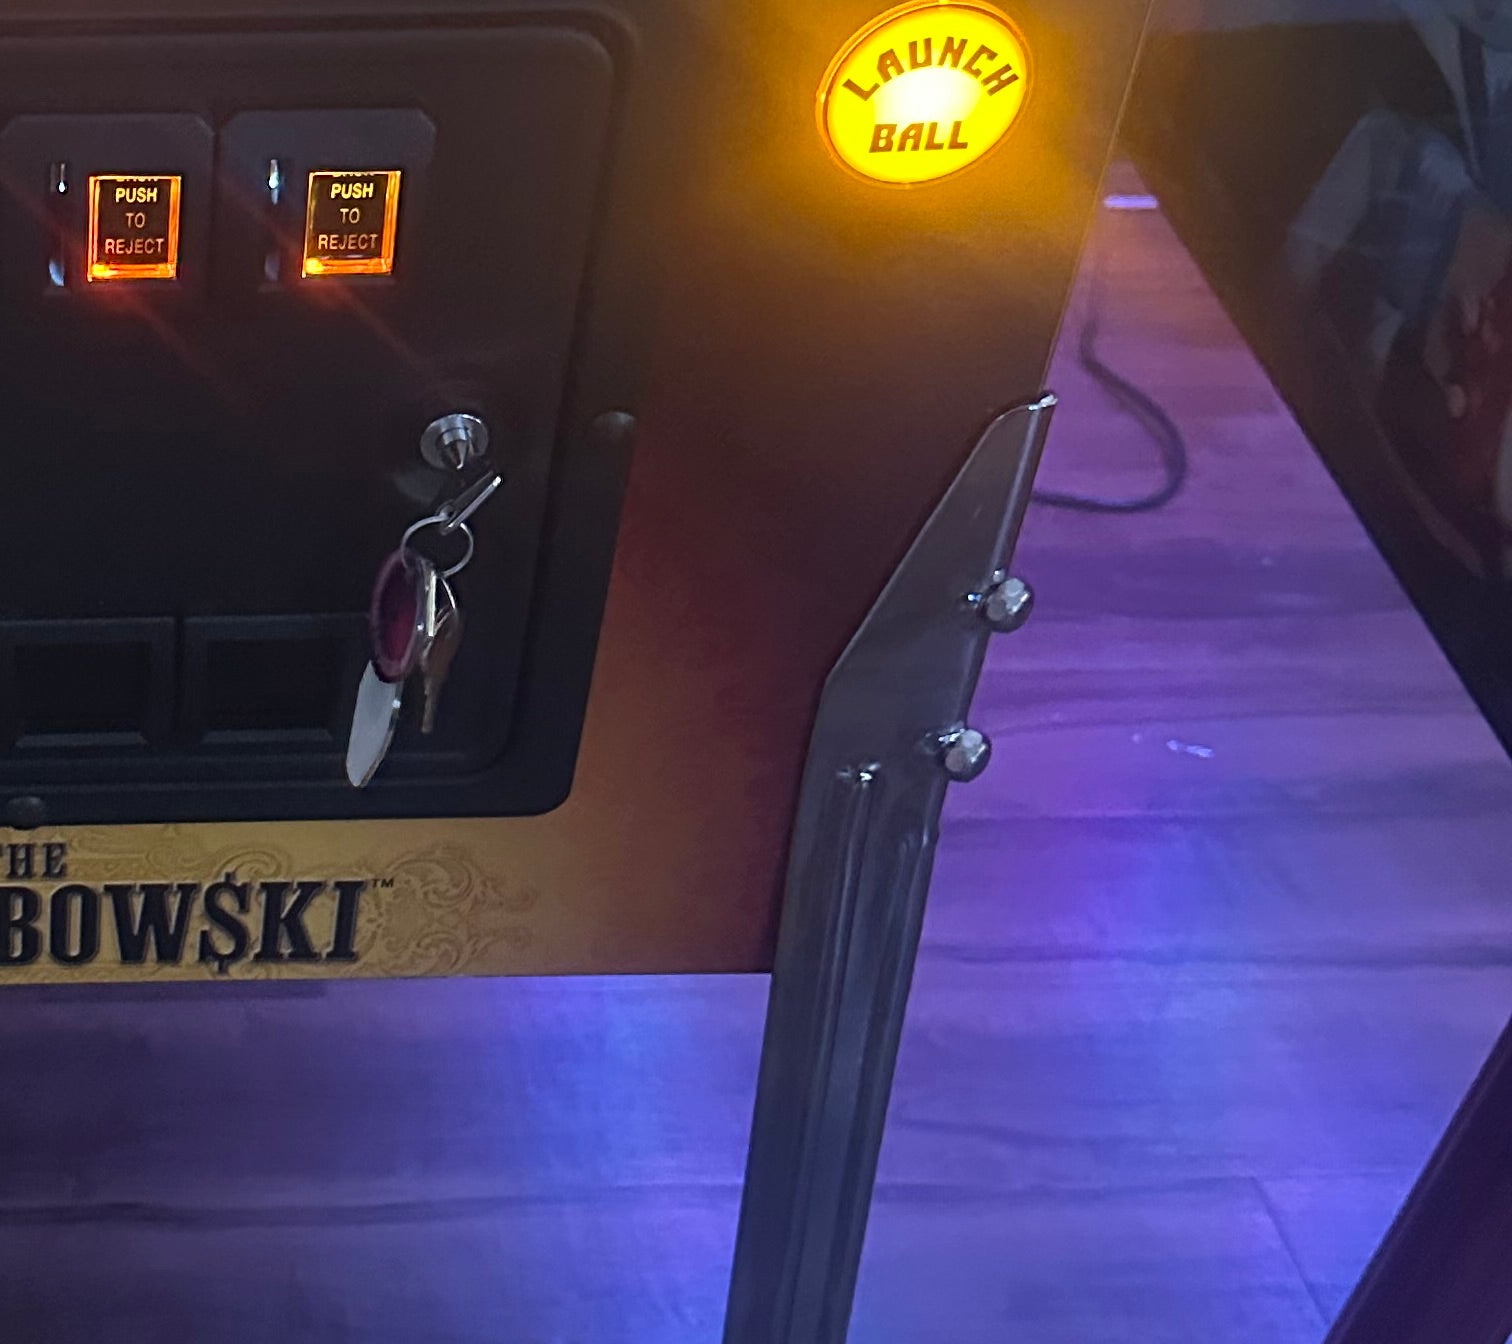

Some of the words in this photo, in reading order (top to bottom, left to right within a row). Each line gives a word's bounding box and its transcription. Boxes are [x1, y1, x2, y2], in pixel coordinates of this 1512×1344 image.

[842, 36, 1019, 102] LAUNCH
[868, 120, 968, 153] BALL
[115, 187, 158, 203] PUSH
[330, 182, 374, 199] PUSH
[125, 212, 145, 229] TO
[339, 207, 360, 224] TO
[104, 238, 165, 255] REJECT
[318, 233, 378, 251] REJECT
